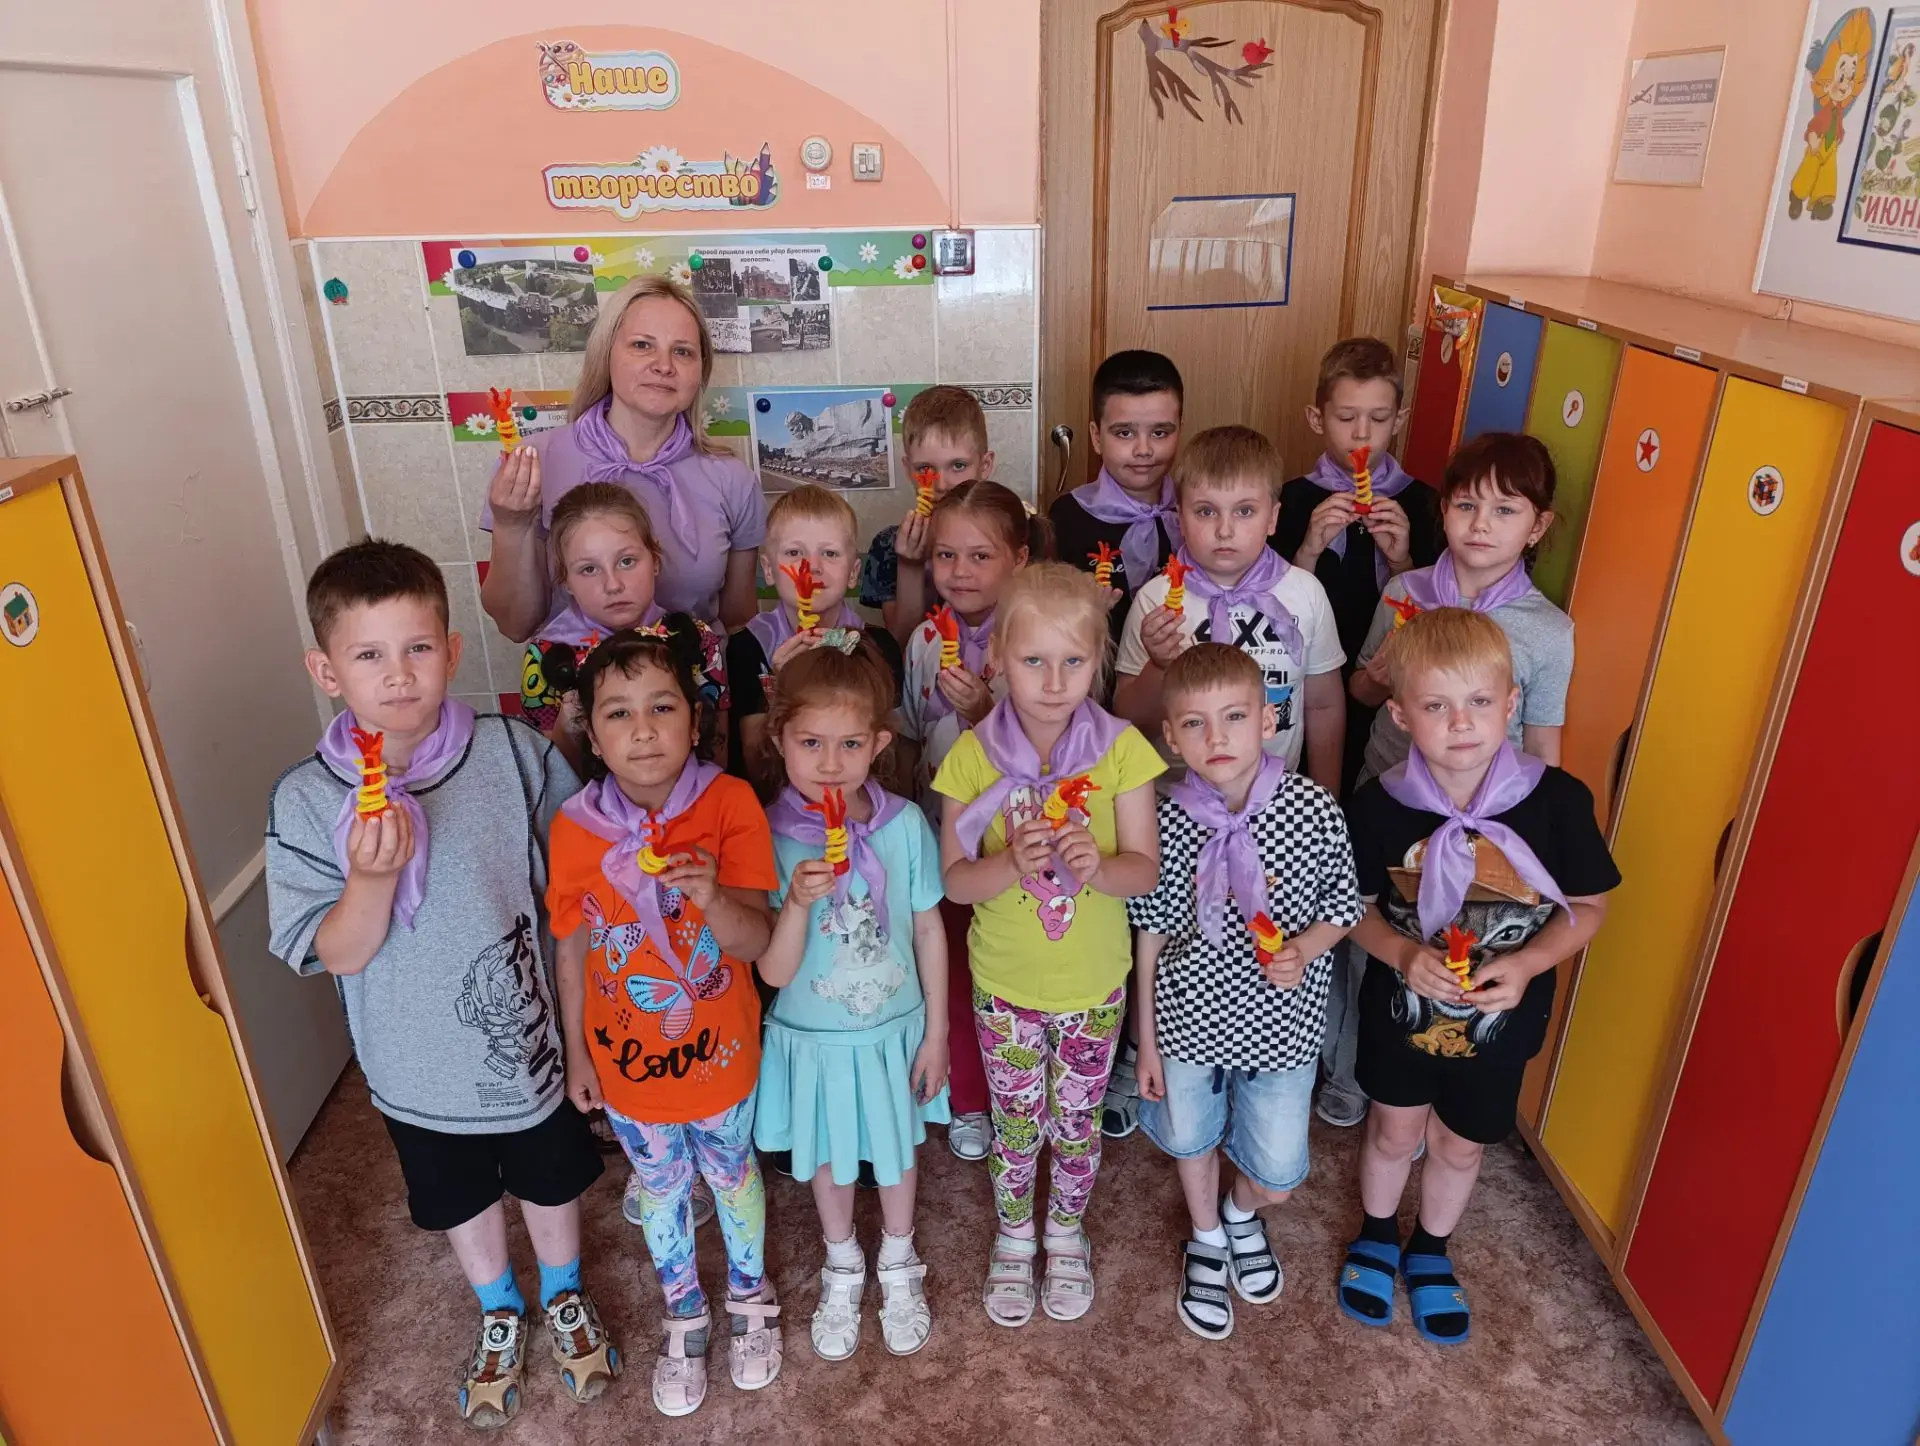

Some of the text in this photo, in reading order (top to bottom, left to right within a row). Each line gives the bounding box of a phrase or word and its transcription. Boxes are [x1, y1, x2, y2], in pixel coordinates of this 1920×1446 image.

[568, 62, 669, 95] Наше
[552, 174, 759, 209] творчество
[1247, 648, 1289, 656] OFF-ROA
